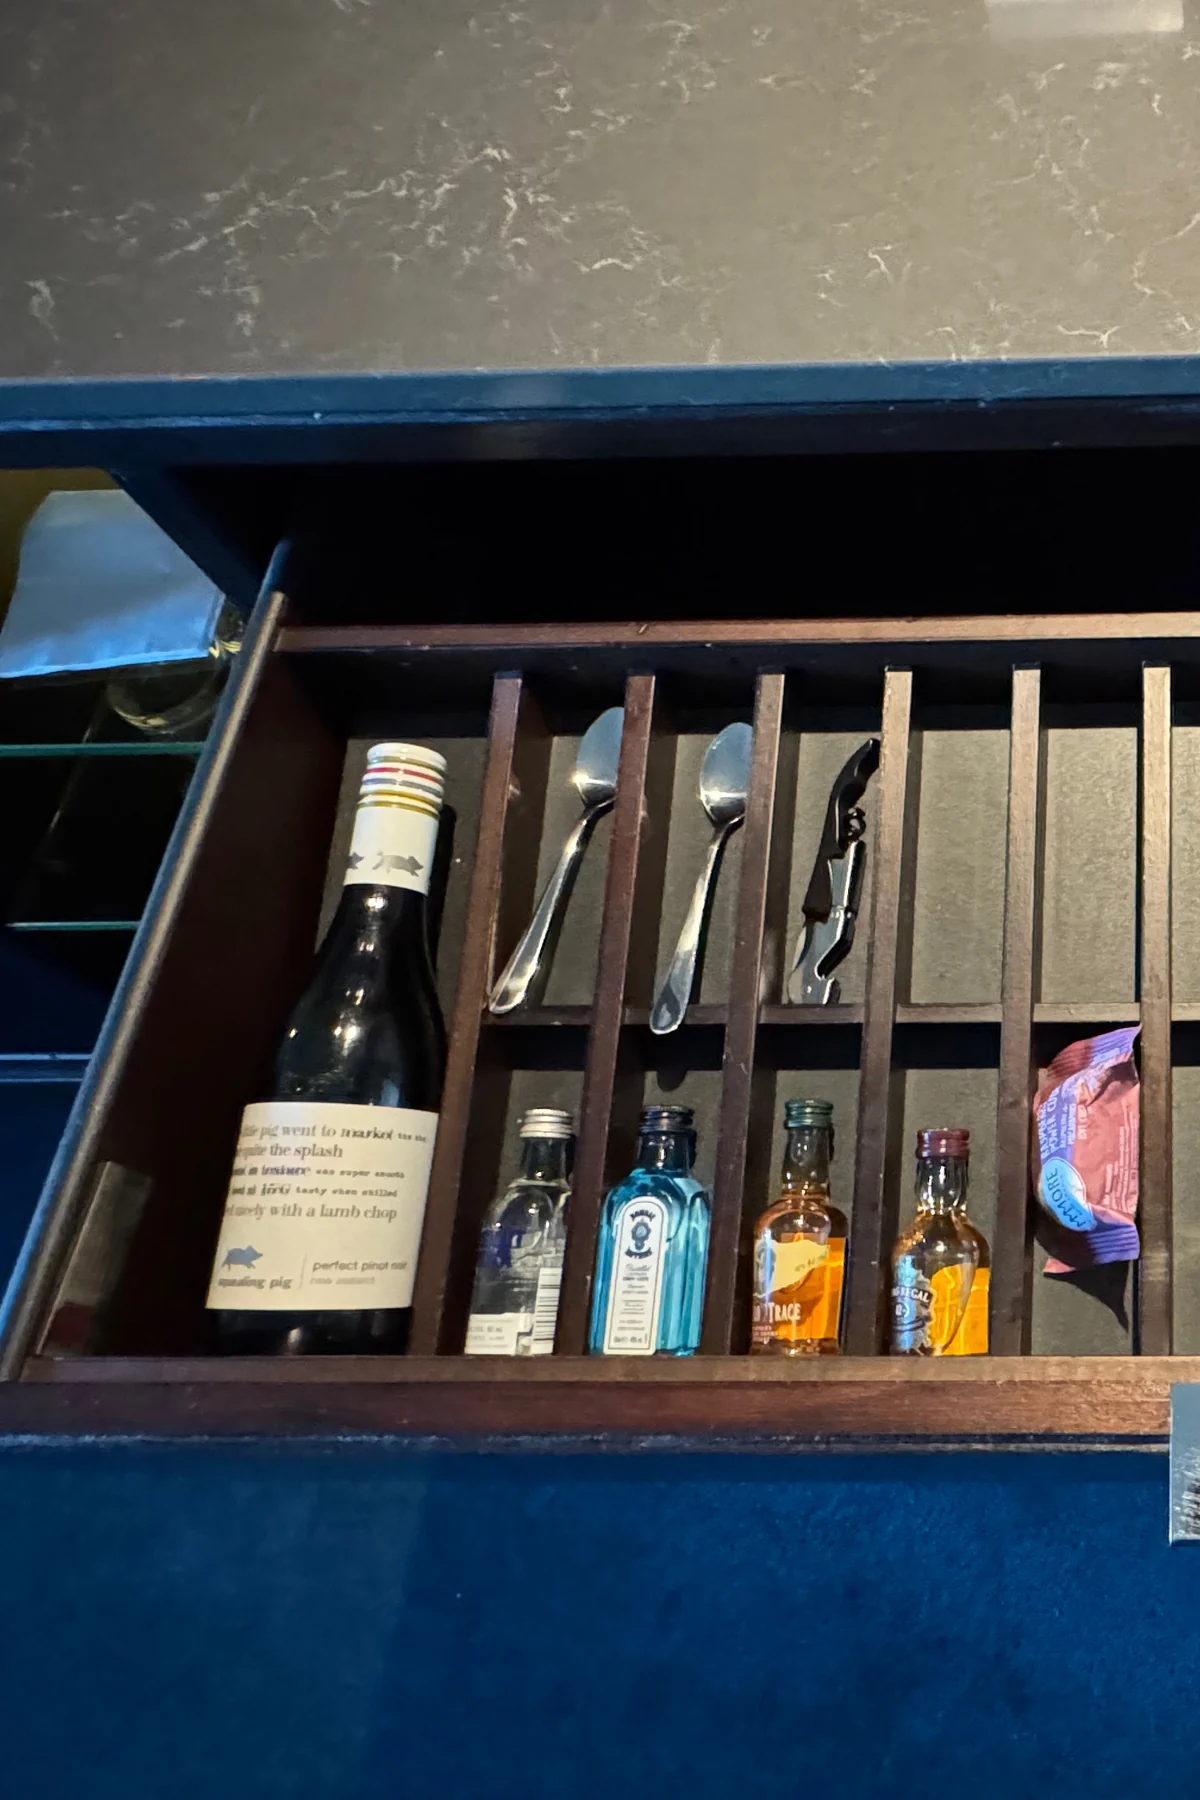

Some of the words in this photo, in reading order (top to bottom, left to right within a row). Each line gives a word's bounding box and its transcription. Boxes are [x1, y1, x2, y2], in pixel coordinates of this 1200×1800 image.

[281, 1124, 317, 1137] went
[321, 1124, 337, 1137] to
[340, 1127, 394, 1141] market
[270, 1143, 291, 1156] the
[294, 1143, 343, 1160] splash
[1046, 1168, 1087, 1228] MMMORE
[270, 1203, 302, 1217] with
[306, 1206, 315, 1217] a
[320, 1203, 361, 1218] lamb
[363, 1205, 398, 1223] chop
[312, 1260, 359, 1273] perfect
[269, 1276, 293, 1289] pig
[768, 1302, 801, 1323] TRACE
